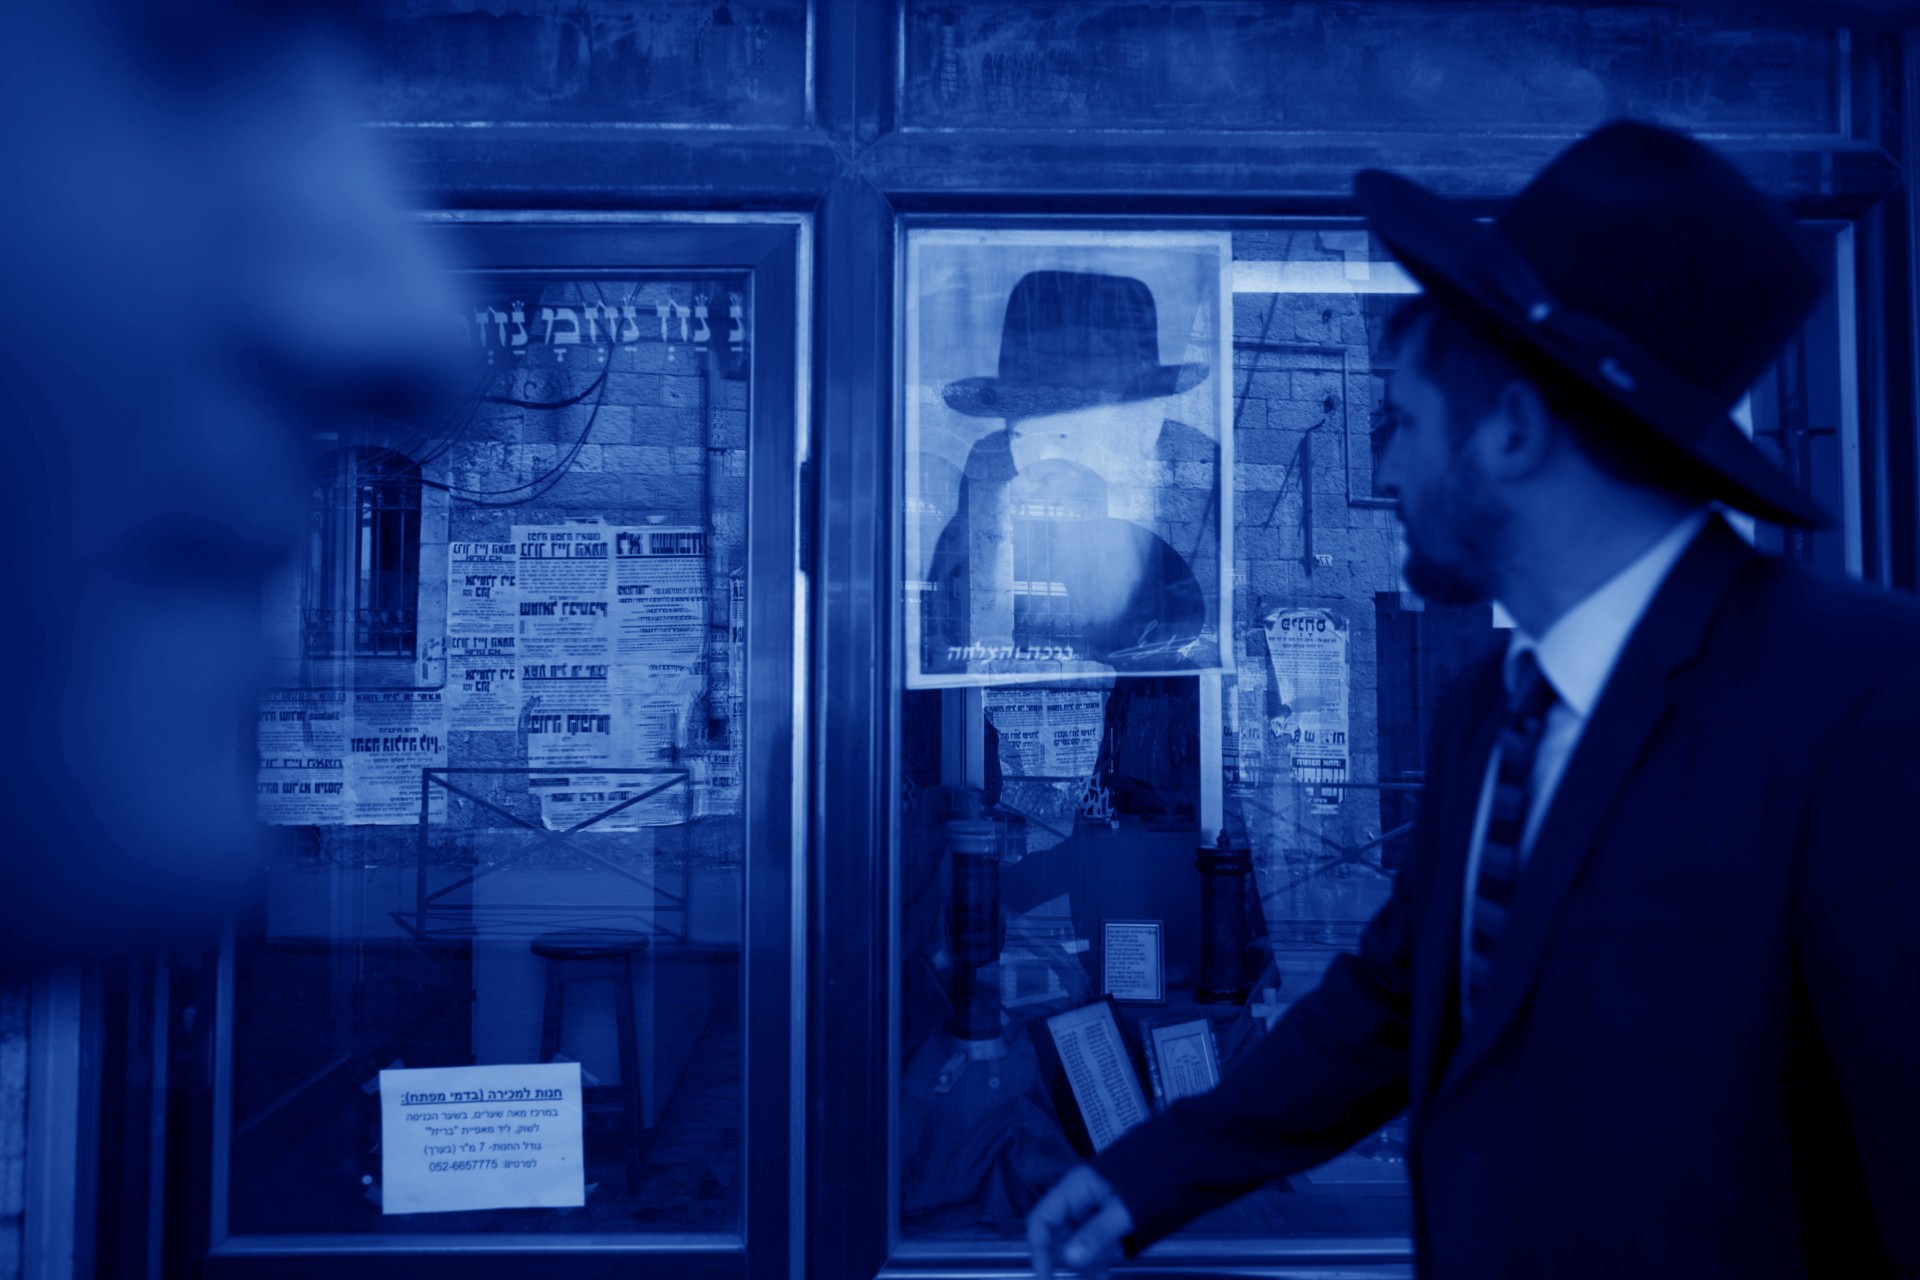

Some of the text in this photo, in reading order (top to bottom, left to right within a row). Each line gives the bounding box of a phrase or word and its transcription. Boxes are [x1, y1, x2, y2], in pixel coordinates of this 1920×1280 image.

[401, 1086, 563, 1104] חנות למכירה (בדמי מפתח):
[406, 1108, 558, 1122] במרכז מאה שערים, בשער הכניסה
[461, 1126, 494, 1135] מאפיית
[497, 1124, 511, 1133] ליד
[514, 1123, 539, 1135] לשוק,
[423, 1144, 456, 1156] (בערך)
[459, 1143, 476, 1153] מ"ר
[479, 1142, 486, 1151] 7
[522, 1141, 542, 1151] גודל
[429, 1159, 498, 1172] 052-6657775
